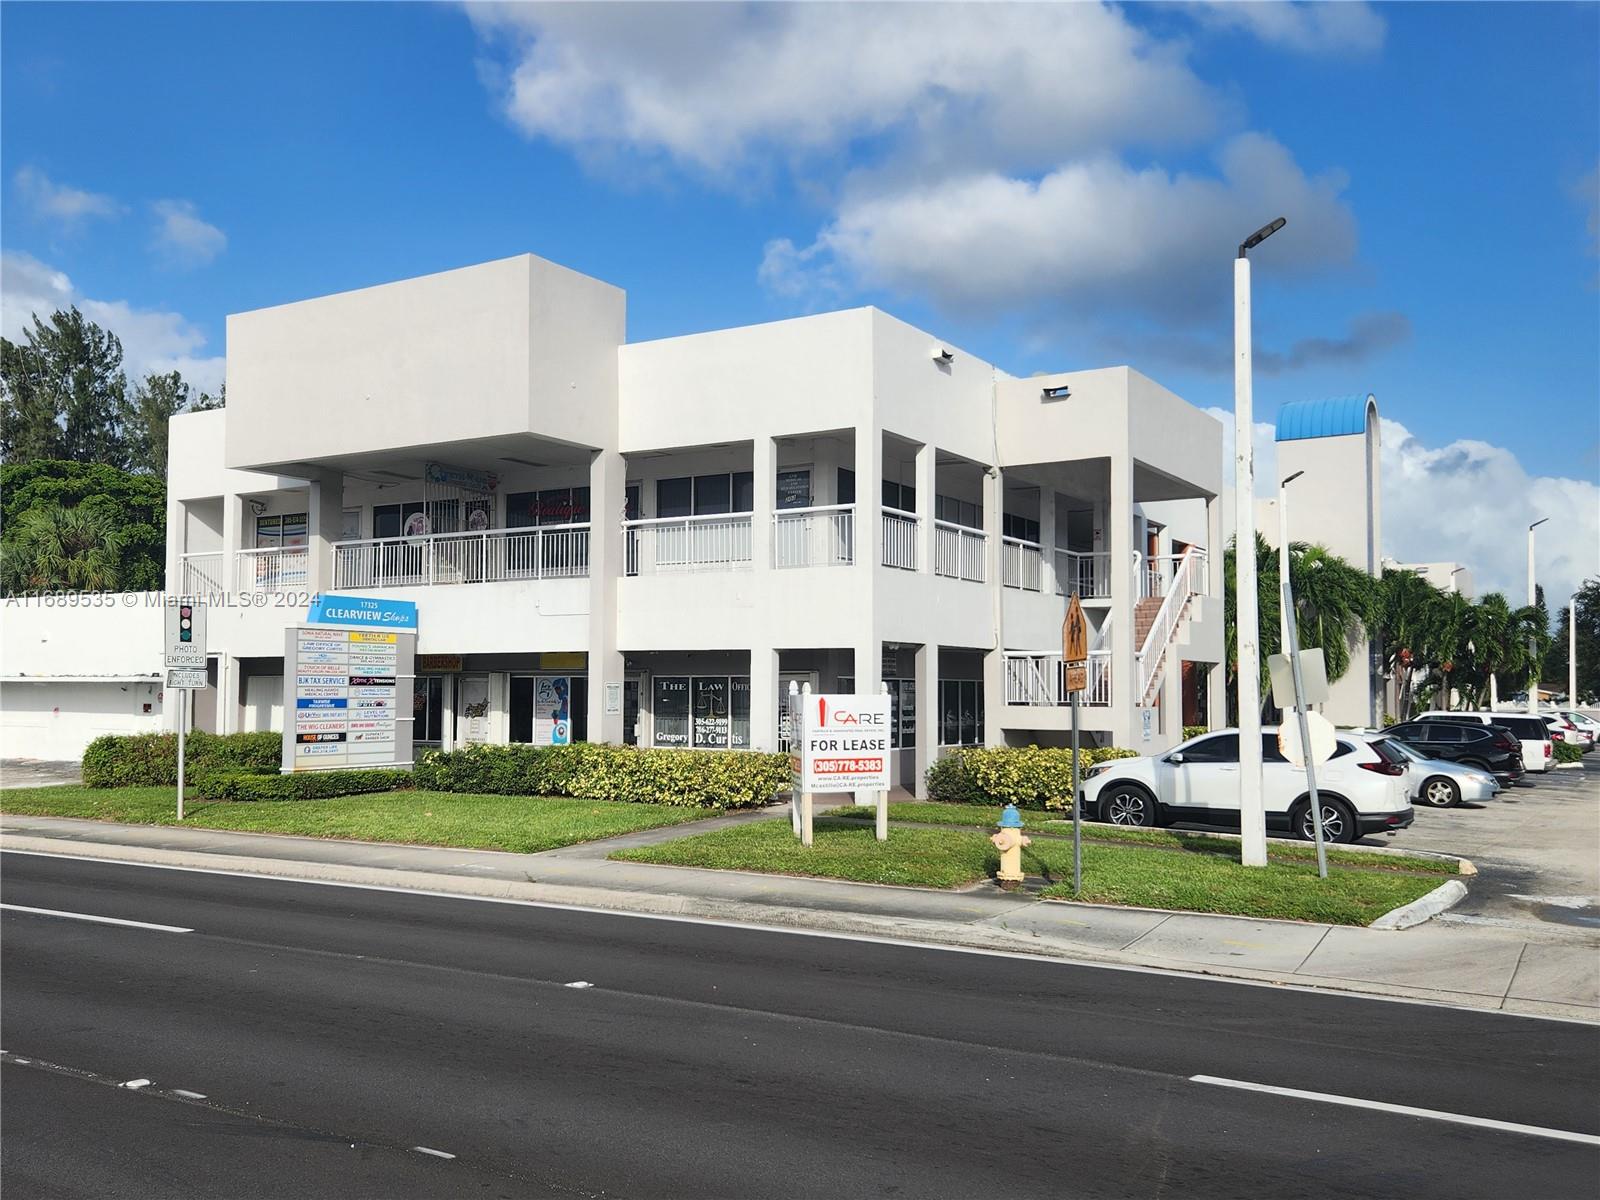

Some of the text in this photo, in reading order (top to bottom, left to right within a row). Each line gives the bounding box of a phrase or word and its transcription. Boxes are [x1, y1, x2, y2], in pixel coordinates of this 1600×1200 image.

[361, 601, 378, 609] 17325
[326, 608, 409, 623] CLEARVIEW Shops
[174, 645, 198, 653] PHOTO
[167, 655, 204, 664] ENFORCED
[298, 677, 345, 685] BJK TAX SERVICE
[656, 732, 688, 743] Gregory
[695, 733, 706, 744] D.
[811, 739, 885, 752] FOR LEASE
[815, 759, 882, 773] (305)778-5383
